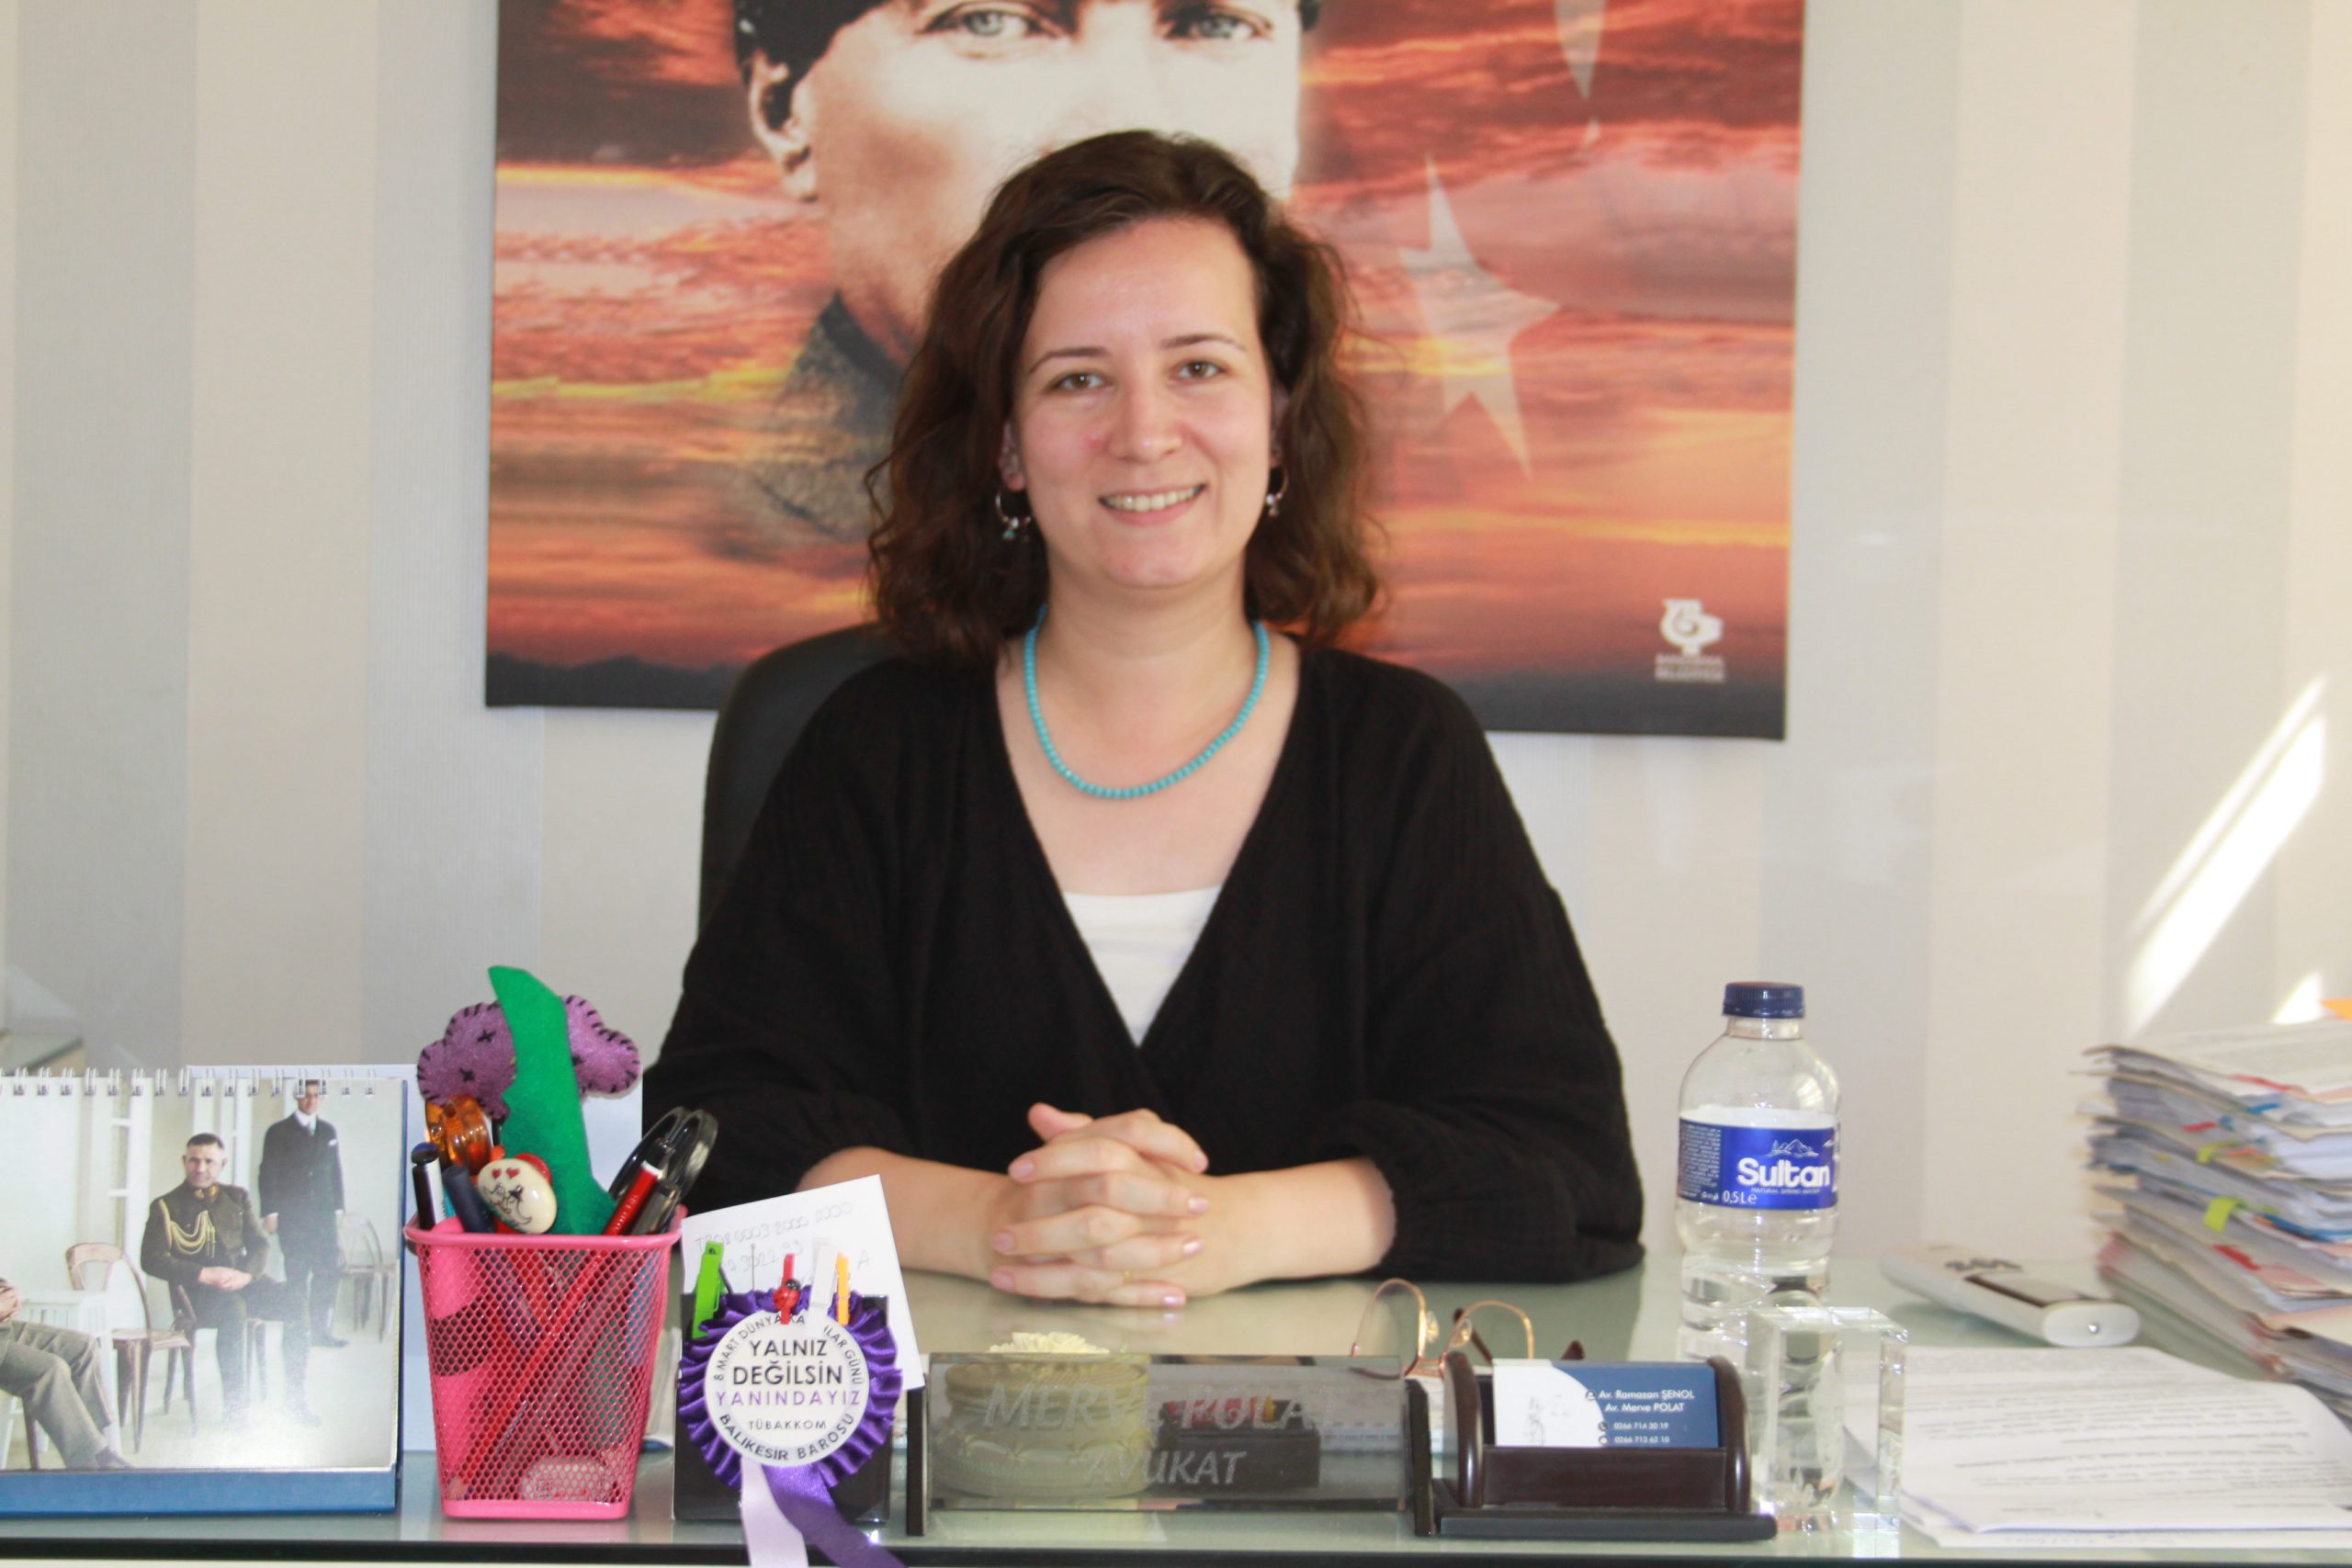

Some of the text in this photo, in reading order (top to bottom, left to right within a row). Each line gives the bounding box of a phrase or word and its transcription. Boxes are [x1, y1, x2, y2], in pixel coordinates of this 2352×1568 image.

[1737, 1157, 1830, 1188] Sultan
[717, 1337, 740, 1370] MART
[844, 1349, 865, 1385] GÜNÜ
[750, 1339, 827, 1357] YALNIZ
[733, 1359, 842, 1385] DEĞİLSİN
[717, 1390, 861, 1406] YANINDAYIZ
[984, 1383, 1349, 1430] MERVE POLAT
[1599, 1389, 1695, 1401] Av. Ramazan ŞENOL
[1604, 1402, 1685, 1412] Av. Merve POLAT
[749, 1417, 827, 1430] TÜBAKKOM
[797, 1413, 854, 1460] BAROSU
[1084, 1450, 1249, 1486] AVUKAT
